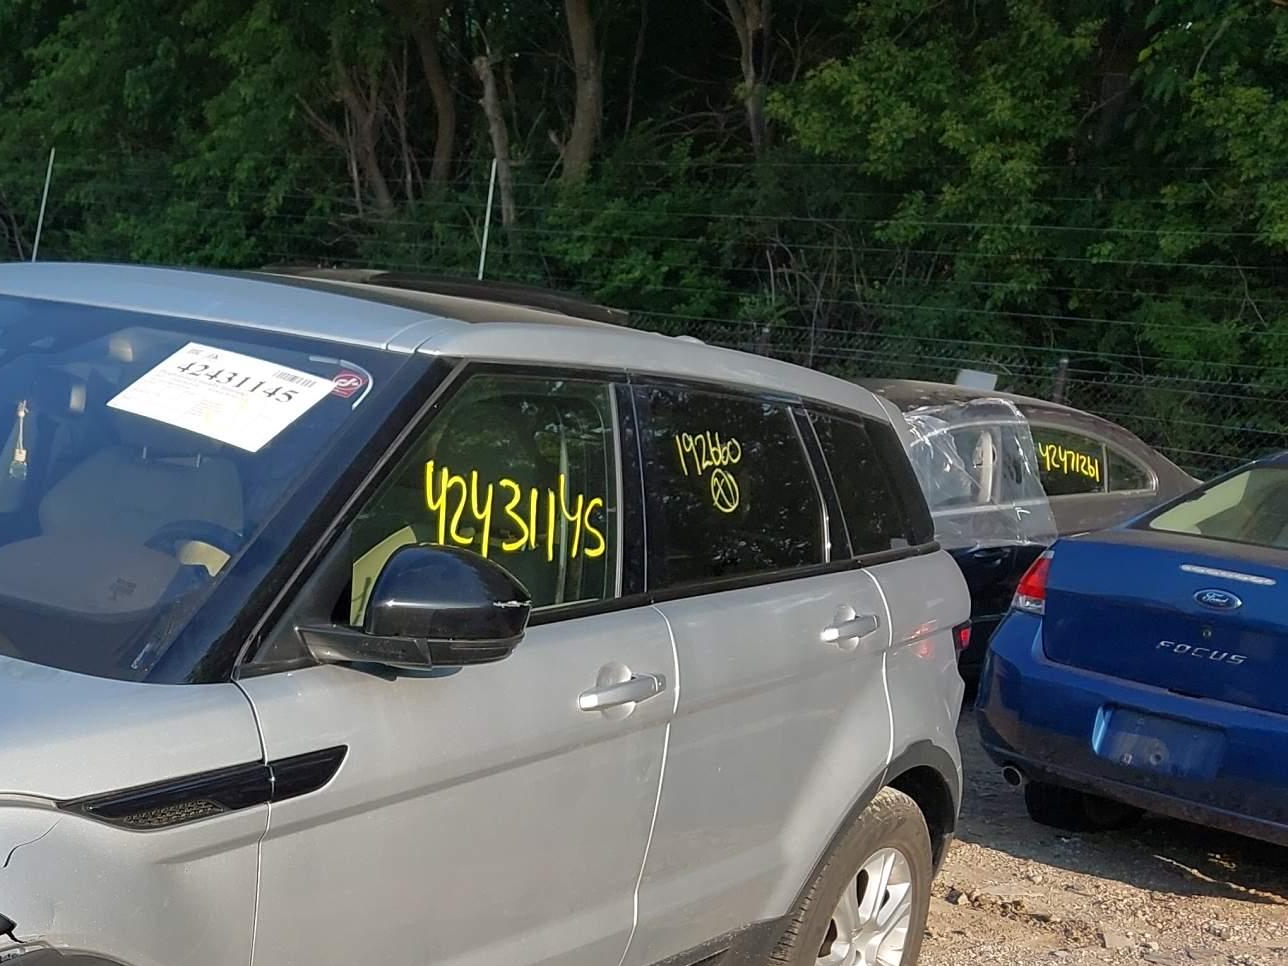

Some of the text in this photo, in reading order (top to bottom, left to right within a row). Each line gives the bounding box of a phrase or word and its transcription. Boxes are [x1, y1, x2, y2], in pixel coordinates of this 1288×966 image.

[176, 361, 300, 403] 42431145
[1038, 442, 1100, 483] 42471261
[425, 459, 606, 562] 42431145
[1156, 640, 1248, 665] FOCUS
